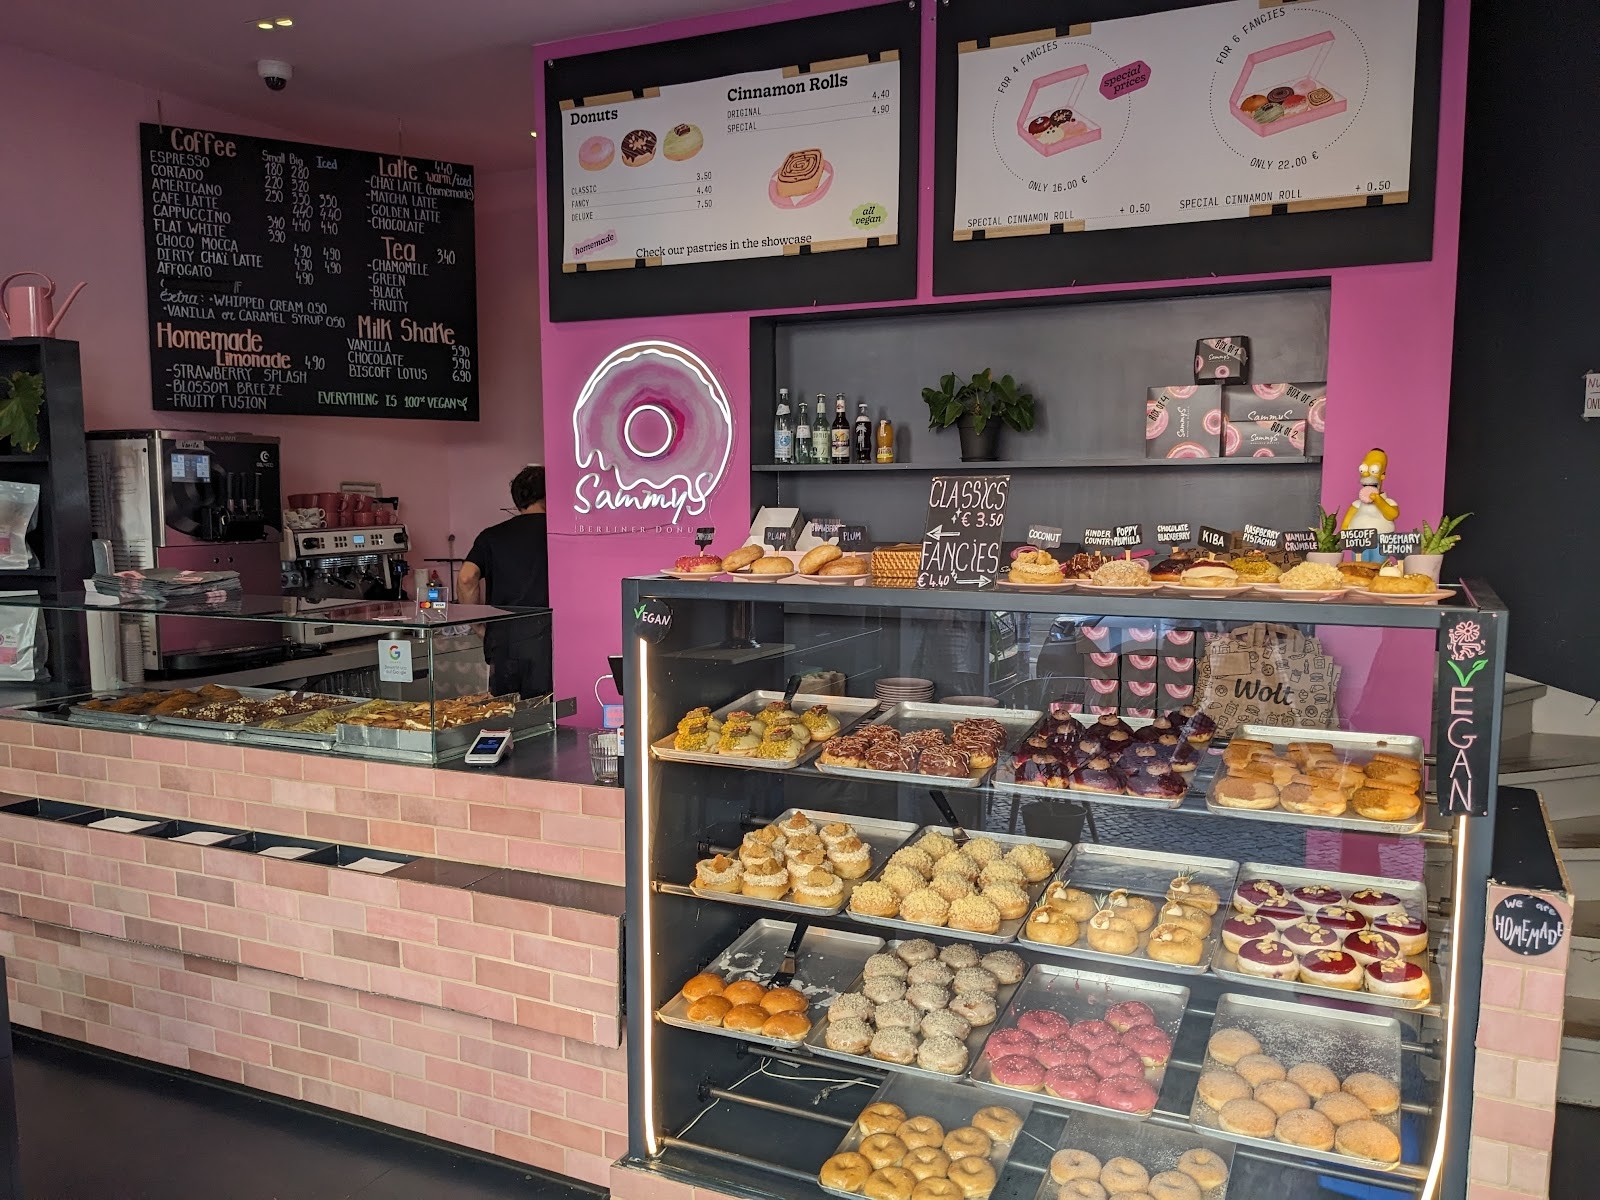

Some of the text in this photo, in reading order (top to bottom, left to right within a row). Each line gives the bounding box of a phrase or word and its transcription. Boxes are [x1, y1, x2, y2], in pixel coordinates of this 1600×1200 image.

[1215, 7, 1286, 65] FOR 6 FANCIES
[997, 40, 1059, 94] FOR 4 FANCIES
[1104, 64, 1142, 88] special
[727, 73, 849, 102] Cinnamon Rolls
[1113, 74, 1147, 95] prices
[727, 89, 890, 119] ORIGINAL 4.40
[570, 109, 619, 126] Donuts
[727, 104, 890, 133] SPECIAL 4.90
[171, 127, 237, 157] Coffee
[150, 150, 210, 168] ESPRESSO
[262, 149, 338, 170] Small Big Iced
[378, 156, 418, 180] Latte
[1250, 150, 1319, 170] ONLY 22.00 €
[151, 164, 204, 180] CORTADO
[152, 178, 222, 196] AMERICANO
[397, 179, 474, 202] LATTE (homemade)
[571, 171, 712, 196] CLASSIC 3.50
[1028, 175, 1088, 193] ONLY 16.00 €
[152, 191, 182, 206] CAFE
[186, 194, 220, 210] LATTE
[411, 194, 439, 210] LATTE
[571, 185, 712, 209] FANCY 4.40
[1179, 180, 1391, 210] SPECIAL CINNAMON ROLL 0.50
[153, 204, 232, 225] CAPPUCCINO
[414, 208, 441, 224] LATTE
[571, 199, 713, 222] DELUXE 7.50
[862, 206, 876, 216] all
[967, 203, 1151, 228] SPECIAL CINNAMON ROLL 0.50
[153, 218, 226, 238] FLAT WHITE
[855, 214, 882, 226] vegan
[156, 233, 238, 253] CHOCO MOCCA
[380, 235, 416, 262] Tea
[574, 233, 615, 255] homemade
[636, 235, 812, 258] Check our pastries in the showcase
[157, 248, 194, 263] DIRTY
[233, 253, 264, 268] LATTE
[156, 262, 212, 278] AFFOGATO
[269, 298, 304, 314] CREAM
[238, 309, 286, 324] CARAMEL
[292, 314, 324, 326] SYRUP
[157, 321, 264, 353] Homemade
[346, 338, 391, 352] VANILLA
[1214, 339, 1227, 352] BOX
[1227, 344, 1235, 354] OF
[216, 349, 292, 369] Limonade
[347, 351, 404, 367] CHOCOLATE
[263, 368, 307, 384] SPLASH
[348, 364, 392, 379] BISCOFF
[397, 366, 428, 381] LOTUS
[237, 382, 283, 396] BREEZE
[1286, 386, 1317, 407] BOX OF 6
[221, 394, 267, 410] FUSION
[318, 390, 379, 406] EVERYTHING
[385, 394, 398, 407] IS
[427, 396, 457, 410] VEGAN
[1148, 408, 1157, 422] BOX
[1270, 421, 1299, 440] BOX OF 2
[929, 480, 1008, 510] CLASSICS
[961, 511, 1004, 528] € 3.50
[1157, 523, 1189, 533] CHOCOLATE
[579, 524, 646, 534] BERLINER
[767, 531, 787, 540] PLAIN
[842, 530, 862, 542] PLUM
[1028, 530, 1062, 544] COCONUT
[1085, 528, 1112, 538] KINDER
[1116, 525, 1138, 537] POPPY
[1157, 531, 1191, 542] BLACKBERRY
[1243, 523, 1281, 541] RASPBERRY
[1285, 532, 1316, 542] VANILLA
[1340, 529, 1375, 542] BISCOFF
[1202, 530, 1225, 548] KIBA
[1242, 532, 1278, 548] PISTACHIO
[1285, 541, 1318, 552] CRUMBLE
[1345, 538, 1372, 549] LOTUS
[1379, 532, 1421, 546] ROSEMARY
[920, 539, 999, 574] FANCIES
[1382, 543, 1414, 554] LEMON
[633, 603, 671, 627] VEGAN
[1234, 678, 1295, 707] Wolt
[1447, 659, 1489, 812] VEGAN
[1535, 902, 1557, 916] are
[1495, 914, 1564, 950] HOMEMADE
